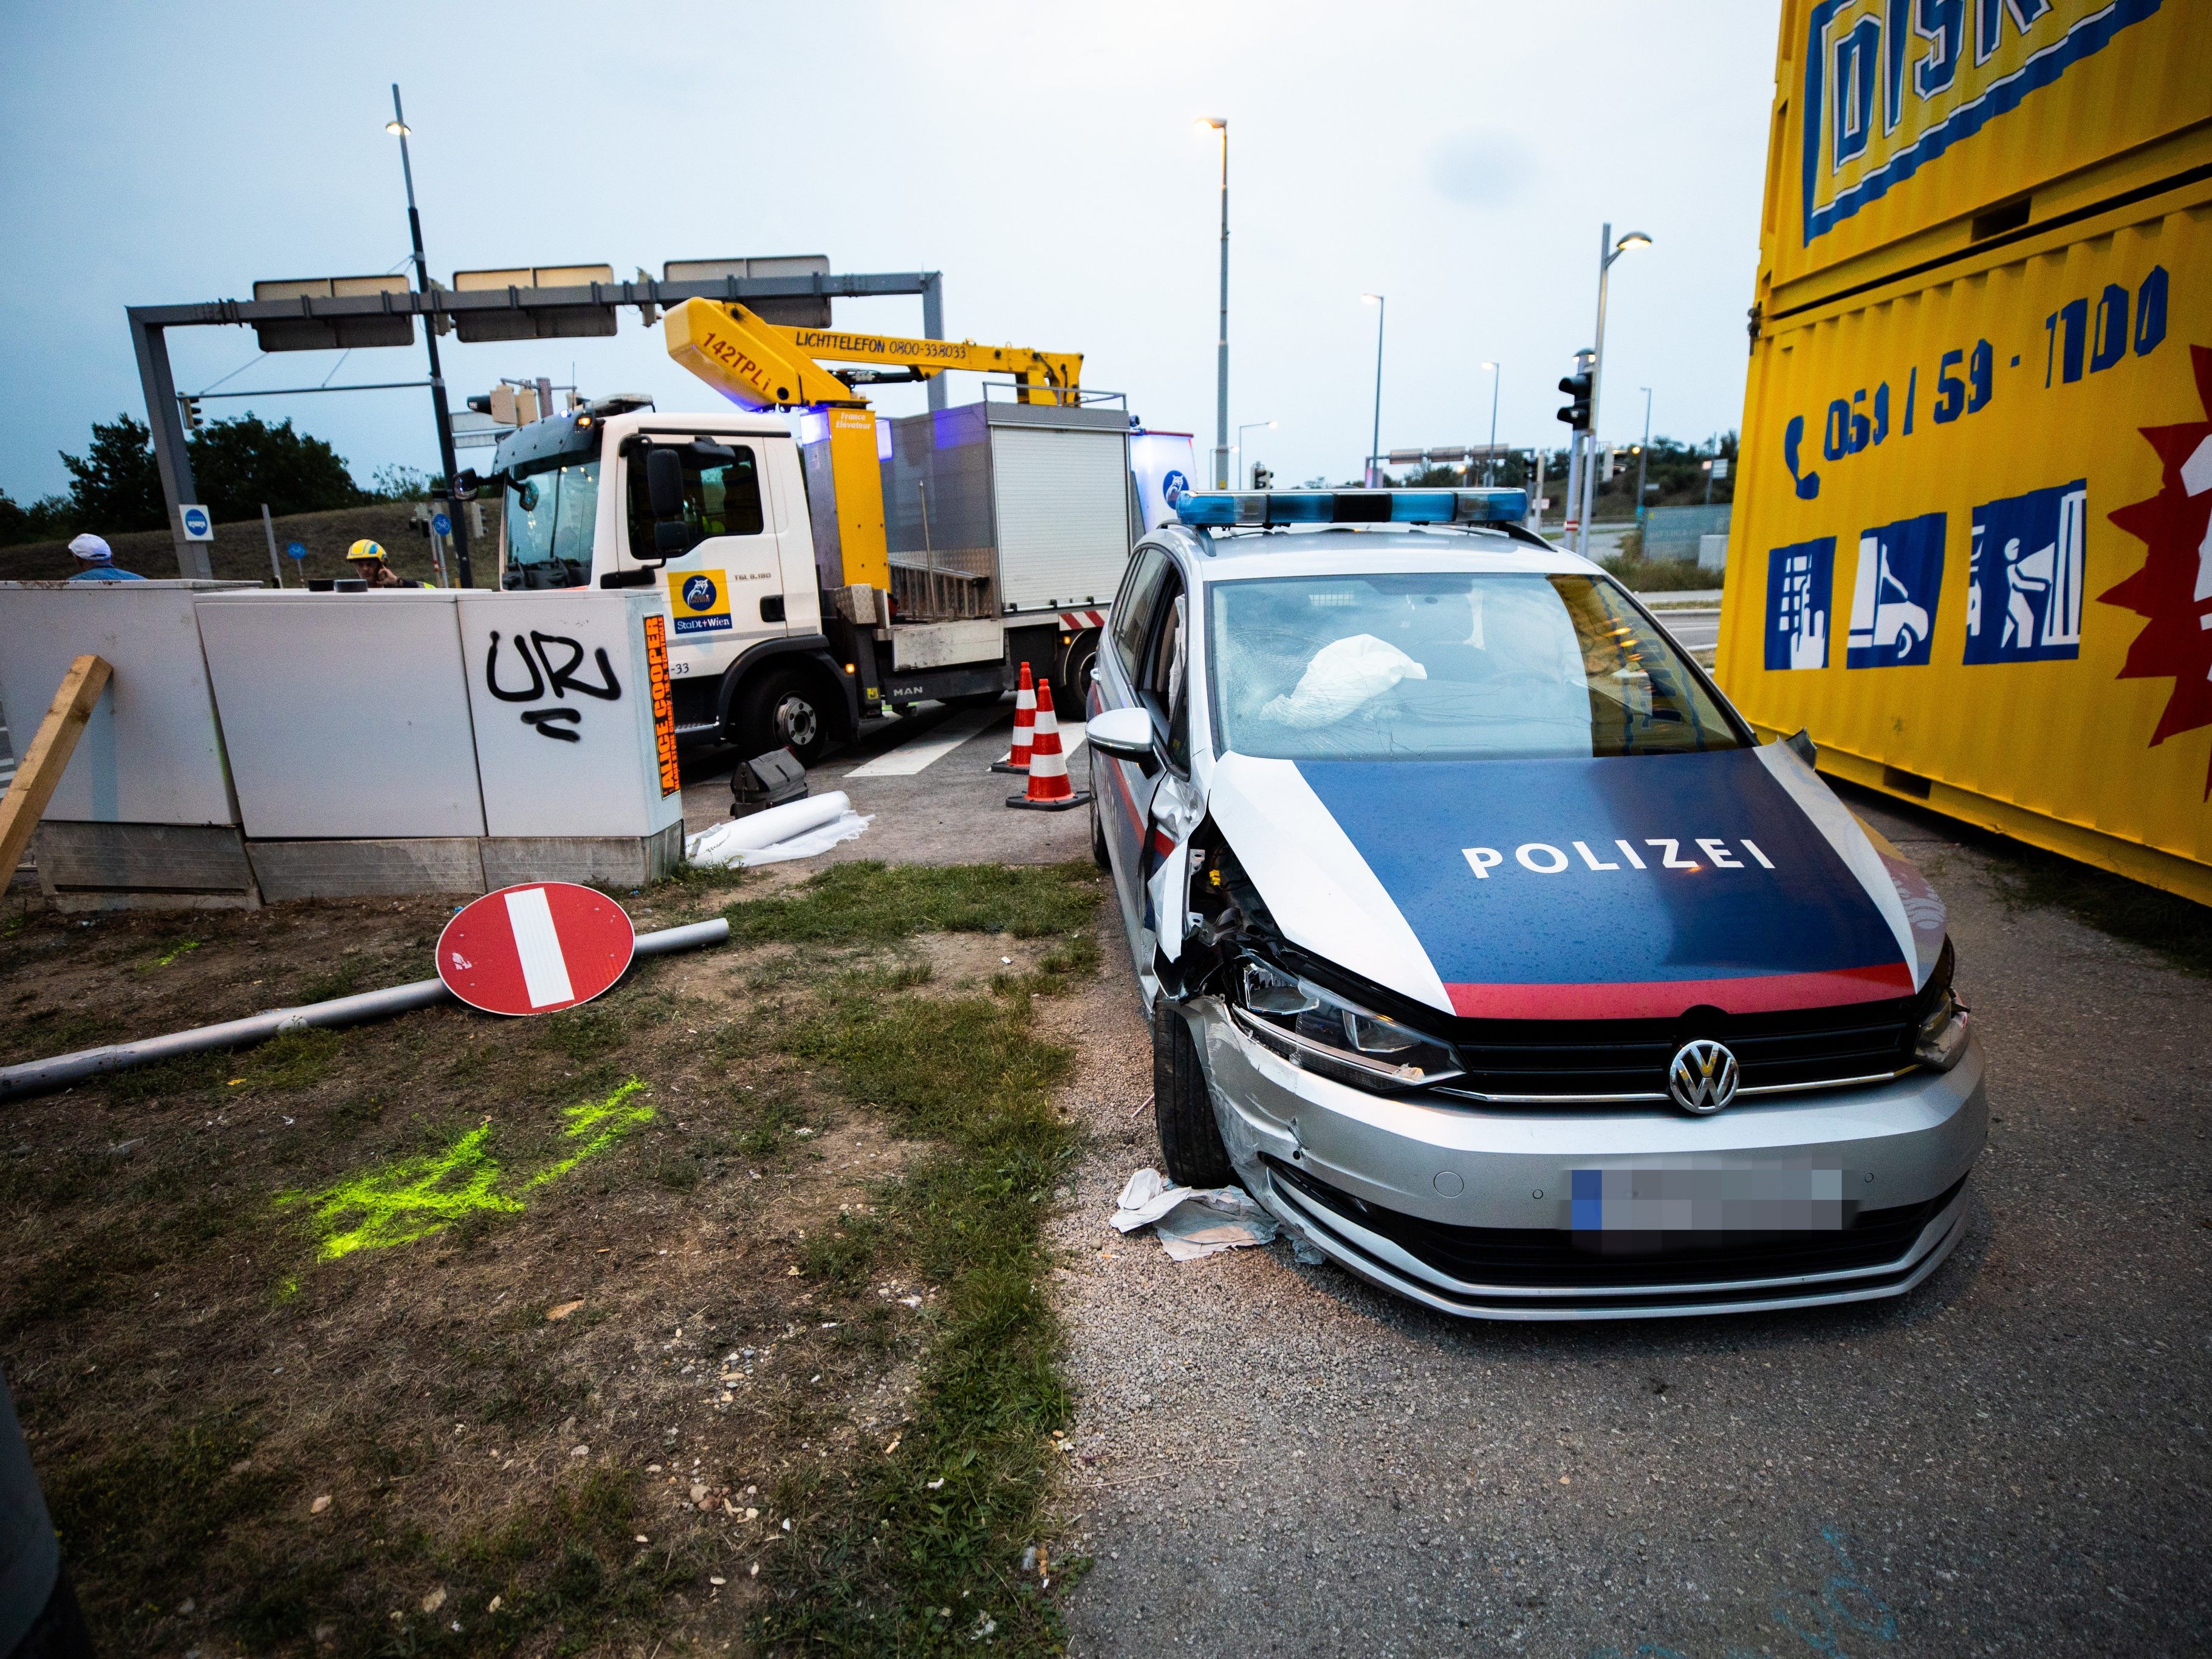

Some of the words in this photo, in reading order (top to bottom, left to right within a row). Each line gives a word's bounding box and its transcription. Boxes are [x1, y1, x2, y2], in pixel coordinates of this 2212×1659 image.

[796, 331, 885, 353] LICHTTELEFON
[889, 340, 966, 358] 0800-338033
[1824, 380, 1889, 461] 059
[1933, 338, 1993, 425] 59
[646, 617, 667, 717] COOPER
[894, 686, 923, 696] MAN
[656, 720, 674, 788] ALICE
[1461, 838, 1775, 879] POLIZEI
